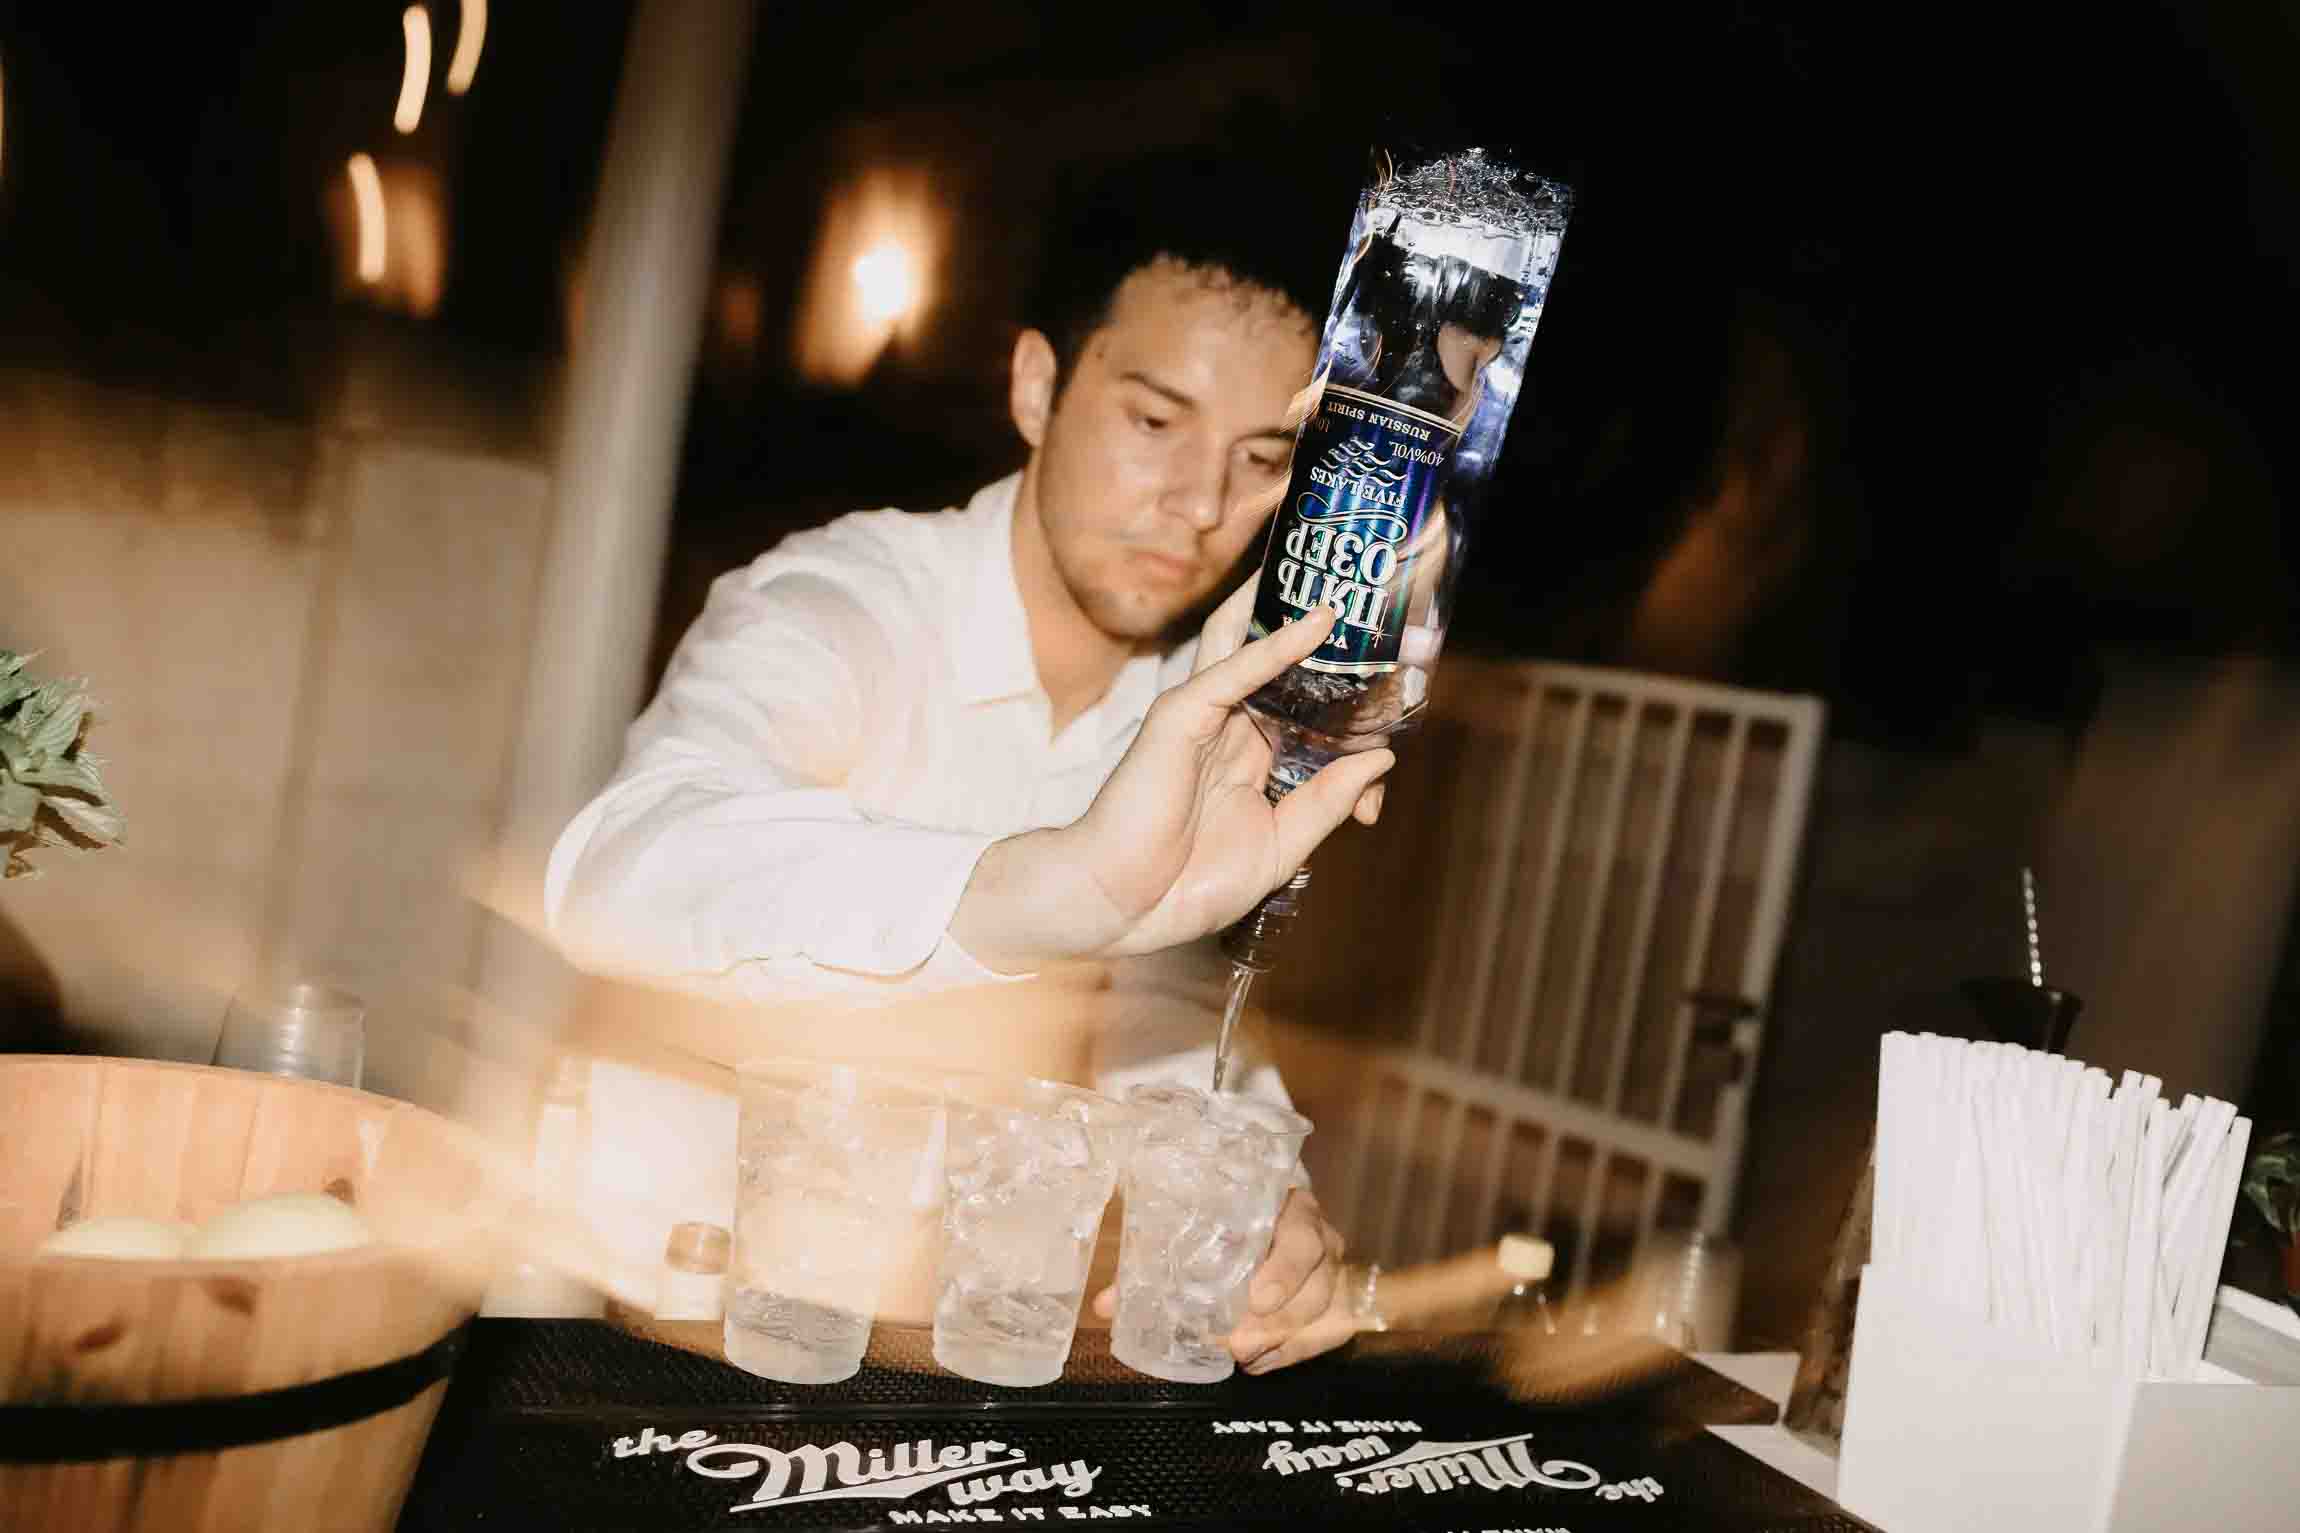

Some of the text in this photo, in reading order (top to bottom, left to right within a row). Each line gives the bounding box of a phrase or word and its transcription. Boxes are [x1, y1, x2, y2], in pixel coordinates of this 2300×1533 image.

[1327, 401, 1431, 441] RUSSIAN SPIRIT
[1309, 466, 1407, 508] FIVE LAKES
[1285, 522, 1398, 586] ОЗЕР
[1277, 557, 1391, 631] ПЯТЬ
[613, 1427, 1010, 1503] the Miller
[1262, 1435, 1391, 1476] way
[1357, 1440, 1665, 1502] the Miller
[947, 1458, 1102, 1505] way
[888, 1509, 1004, 1525] MAKE
[1010, 1507, 1046, 1522] IT
